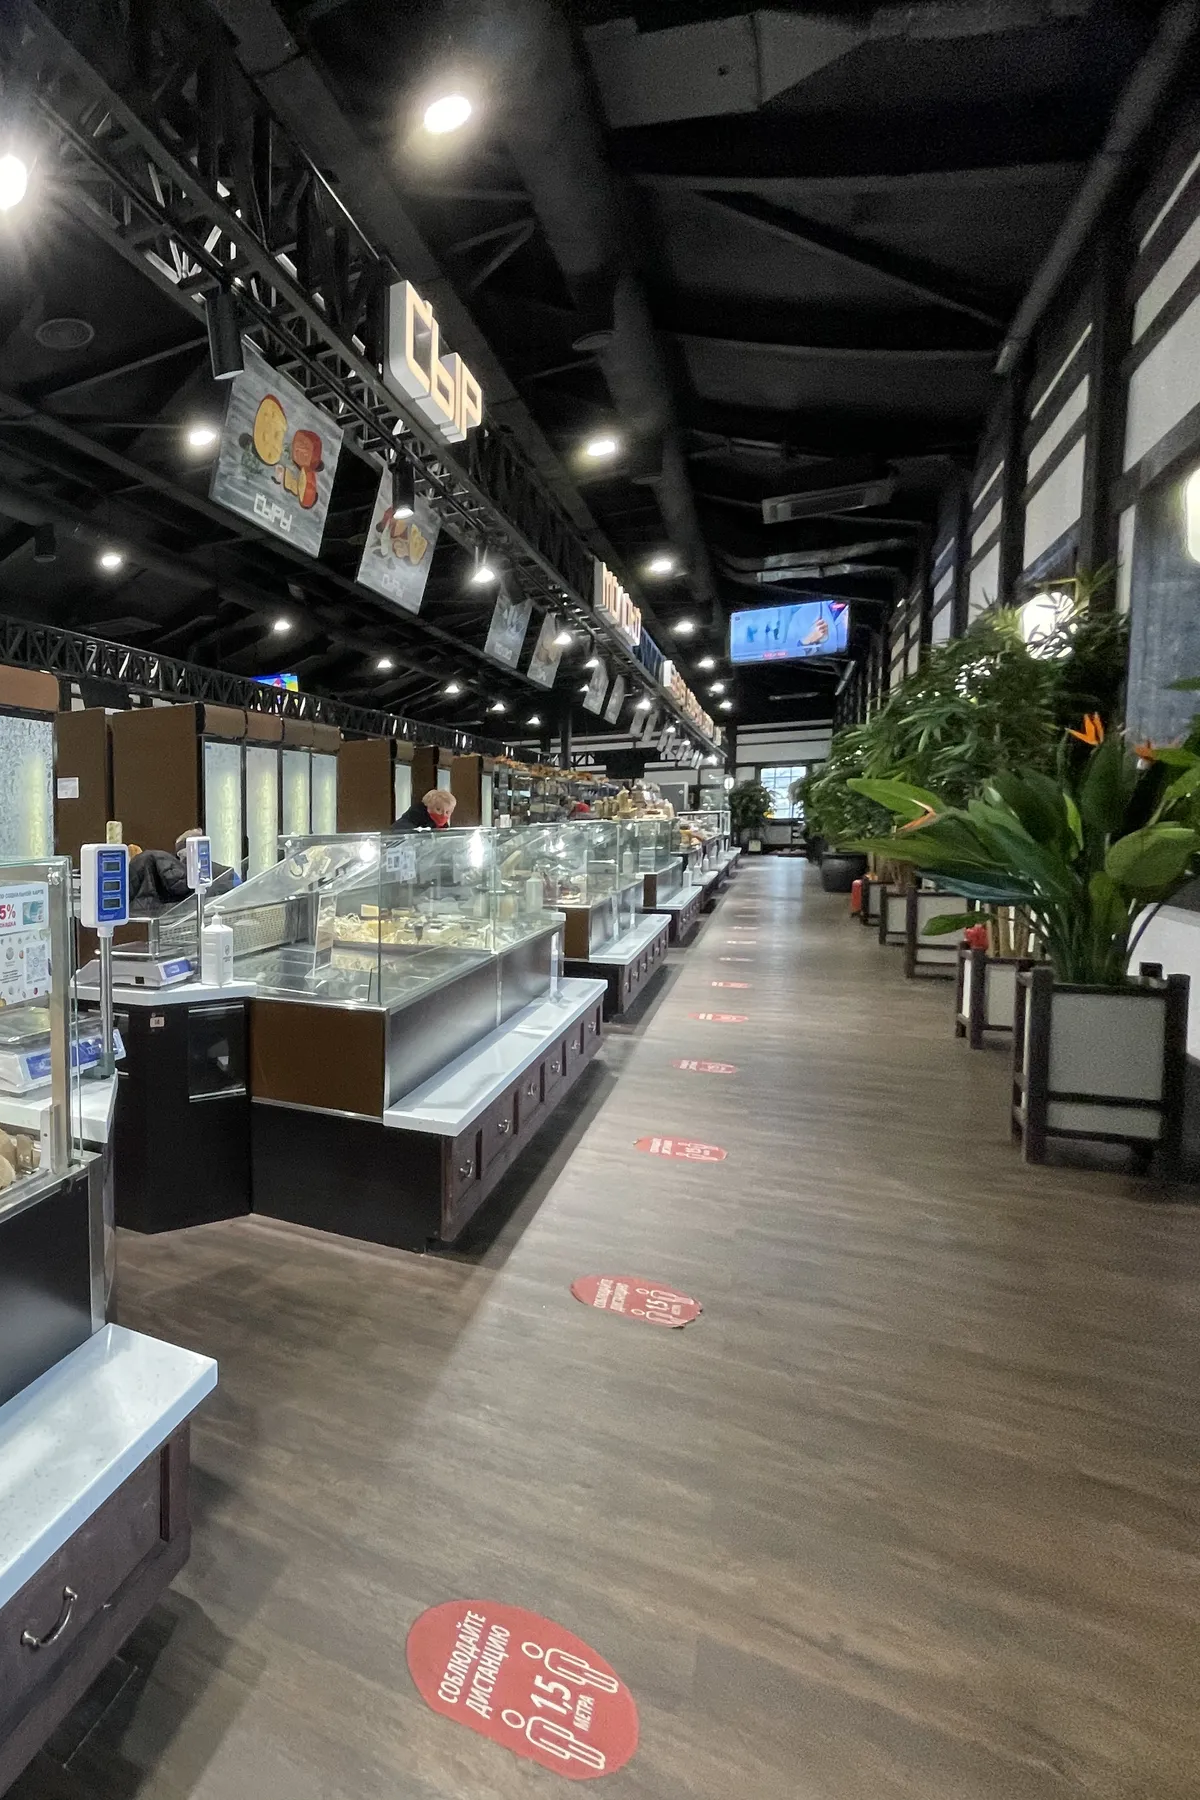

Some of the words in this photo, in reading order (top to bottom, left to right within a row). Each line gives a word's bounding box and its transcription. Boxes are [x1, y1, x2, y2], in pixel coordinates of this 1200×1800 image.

[0, 904, 16, 920] 5%
[437, 1610, 487, 1704] СОБЛЮДАЙТЕ
[465, 1624, 511, 1720] ДИСТАНЦИЮ
[530, 1674, 573, 1715] 1,5
[573, 1694, 595, 1732] МЕТРА
